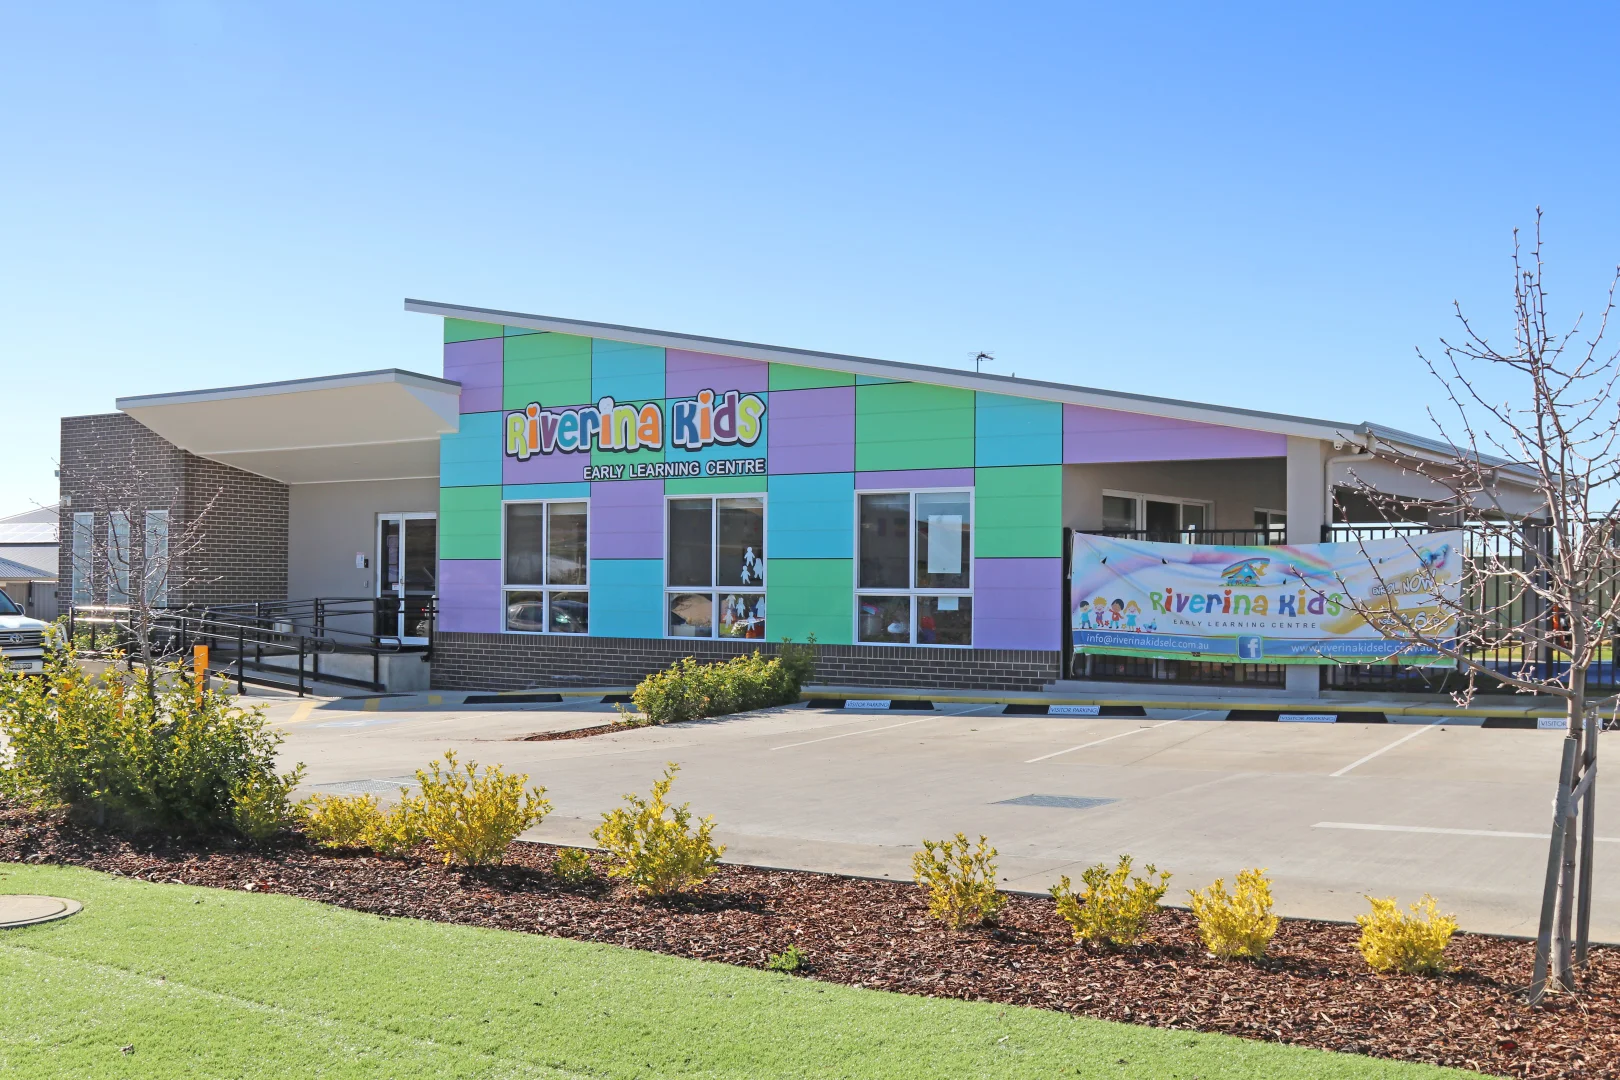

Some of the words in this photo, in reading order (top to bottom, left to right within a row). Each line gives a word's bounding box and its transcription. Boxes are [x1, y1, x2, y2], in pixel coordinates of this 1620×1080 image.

[505, 397, 664, 460] Riverina
[583, 464, 625, 480] EARLY
[629, 461, 700, 478] LEARNING
[705, 458, 766, 475] CENTRE
[1371, 582, 1400, 596] ENROL
[1402, 569, 1437, 595] NOW
[1149, 587, 1269, 616] Riverina
[1173, 619, 1203, 627] EARLY
[1207, 620, 1266, 629] LEARNING
[1270, 621, 1317, 629] CENTRE
[1086, 633, 1209, 649] info@riverinakidselc.com.au
[847, 700, 866, 708] VISITOR
